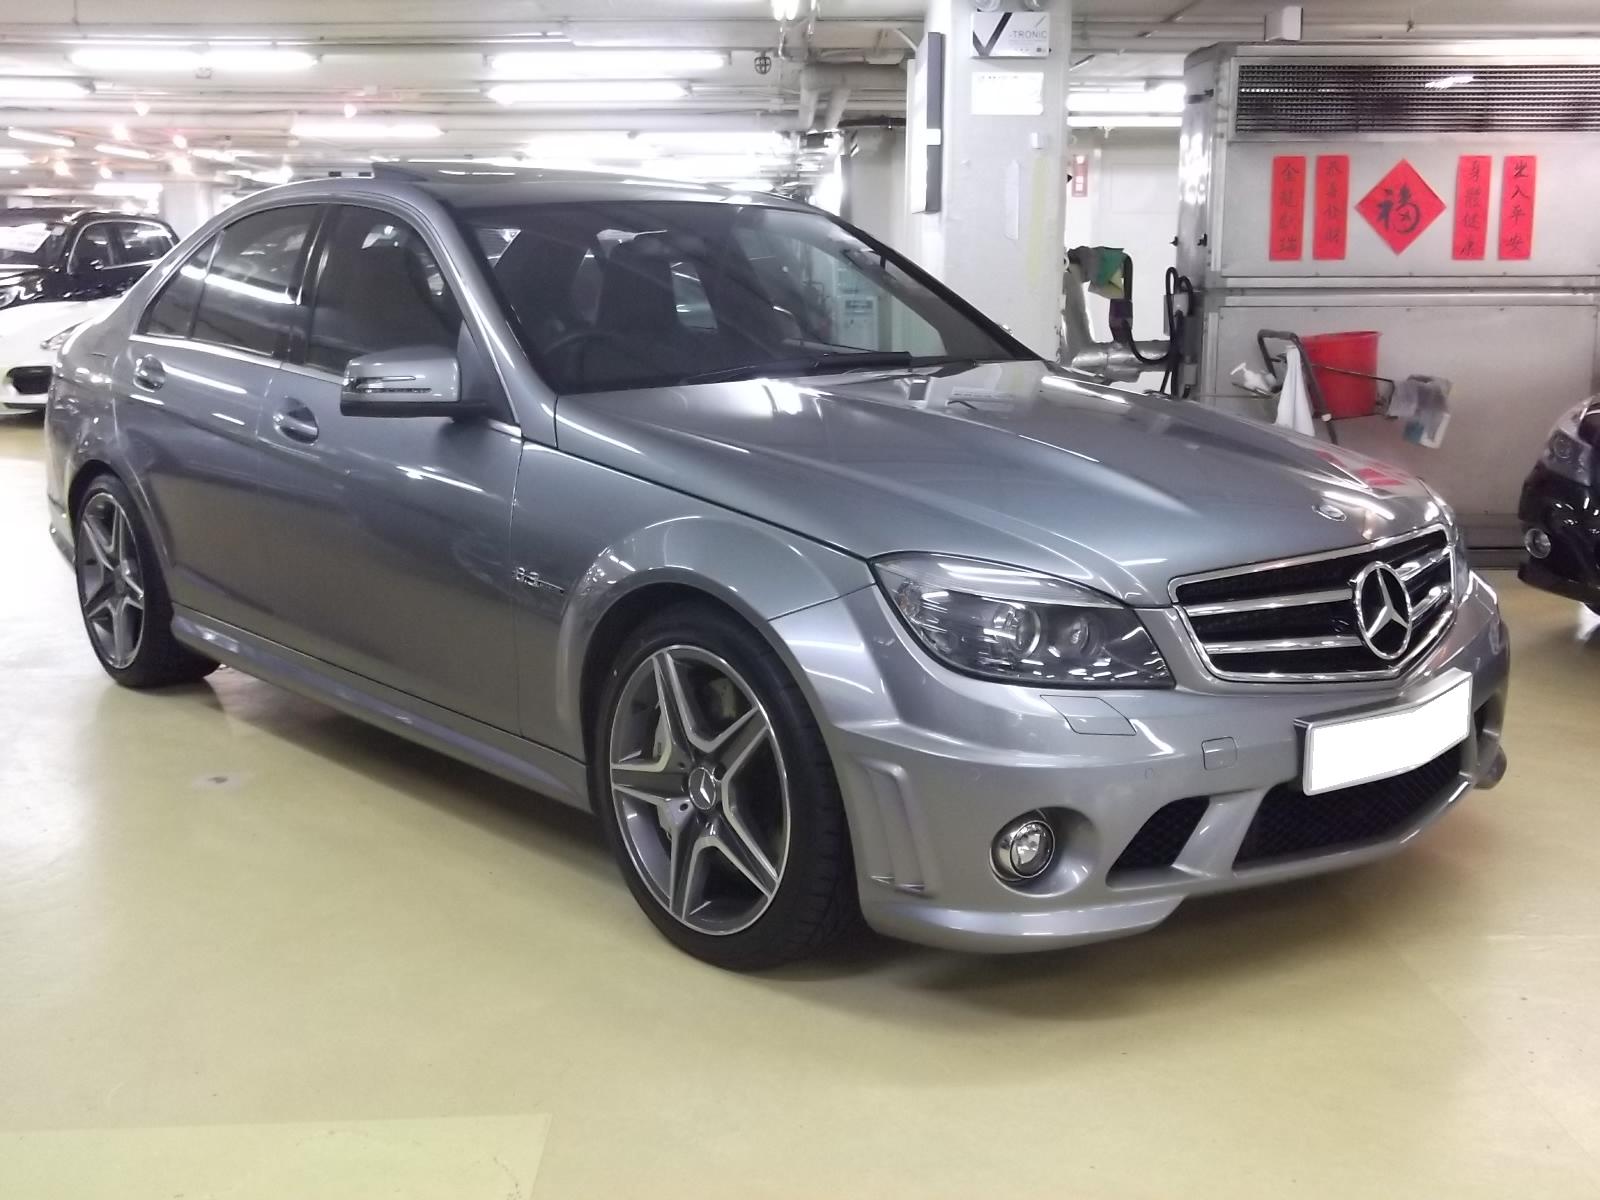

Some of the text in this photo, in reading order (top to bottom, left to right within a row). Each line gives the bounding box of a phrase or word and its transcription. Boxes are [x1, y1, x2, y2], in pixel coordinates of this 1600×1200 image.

[1376, 184, 1421, 234] 福
[1506, 160, 1529, 251] 出入平安
